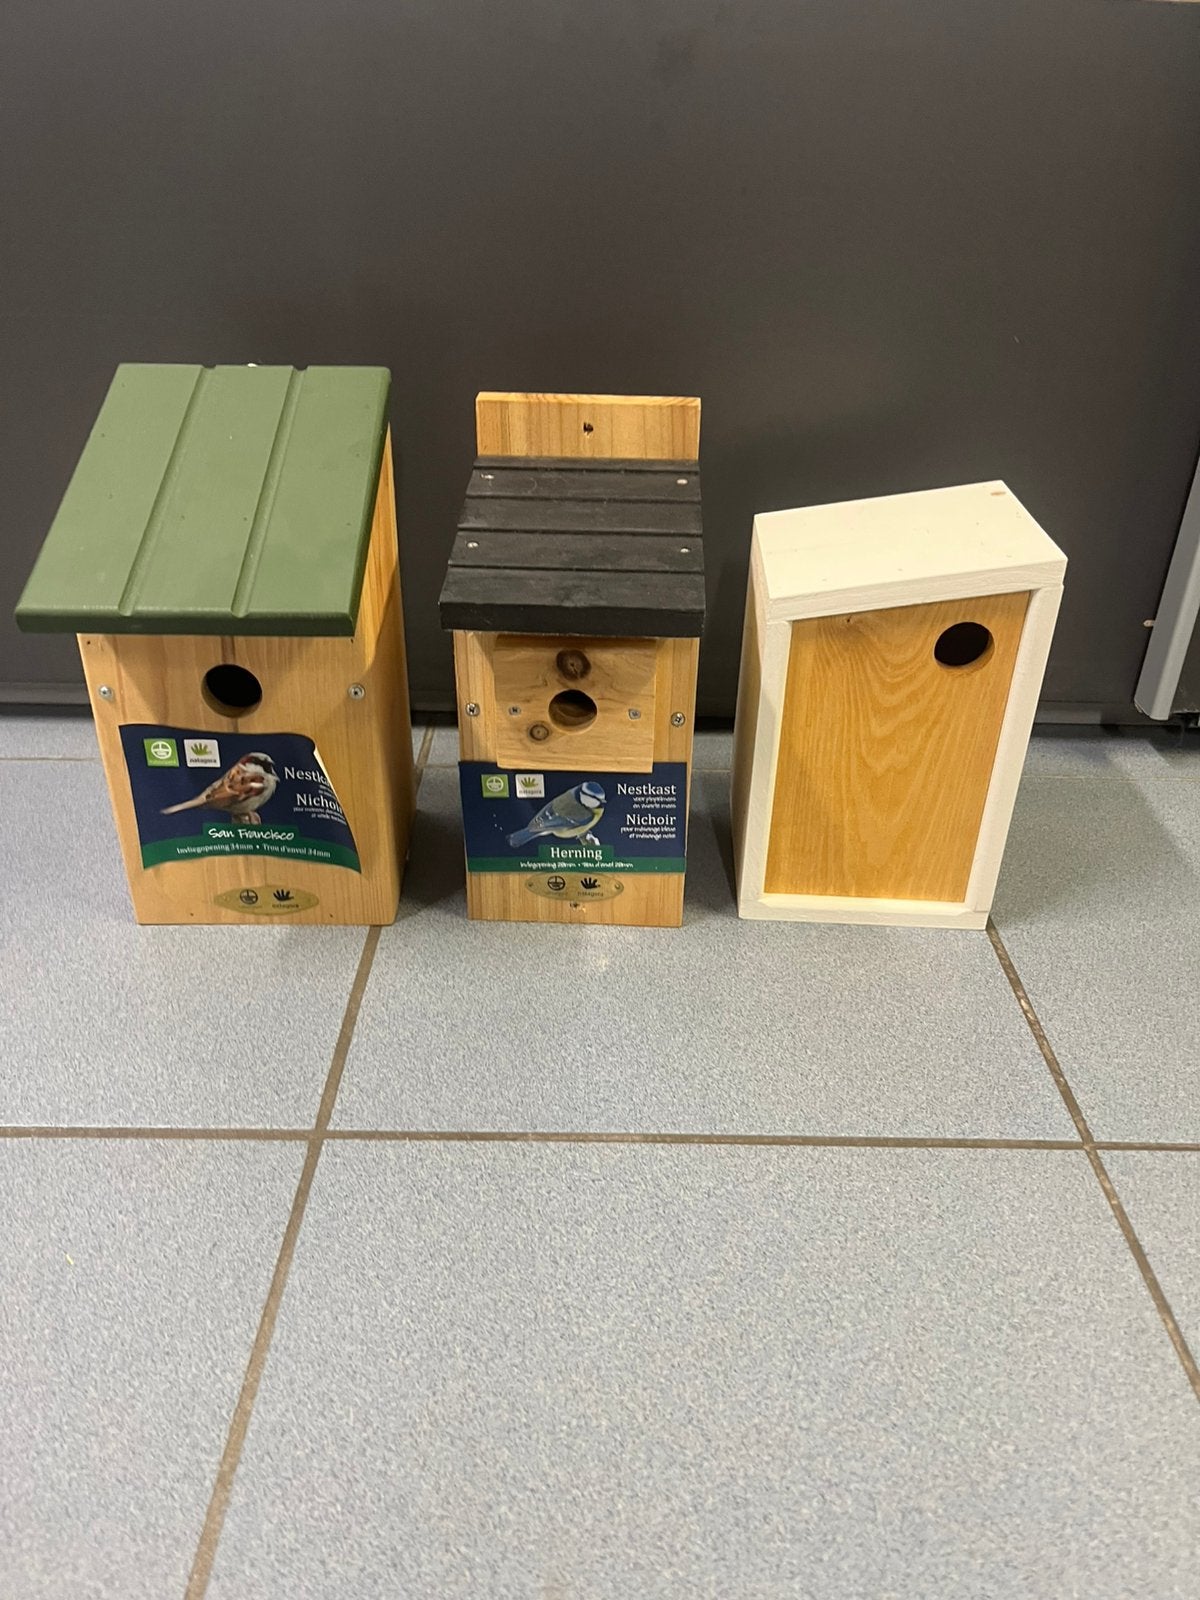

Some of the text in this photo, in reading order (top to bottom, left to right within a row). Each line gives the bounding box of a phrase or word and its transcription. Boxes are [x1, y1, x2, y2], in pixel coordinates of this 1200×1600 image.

[617, 783, 676, 795] Nestkast
[626, 813, 676, 825] Nichoir
[208, 827, 295, 841] San Francisco
[550, 847, 603, 860] Herning
